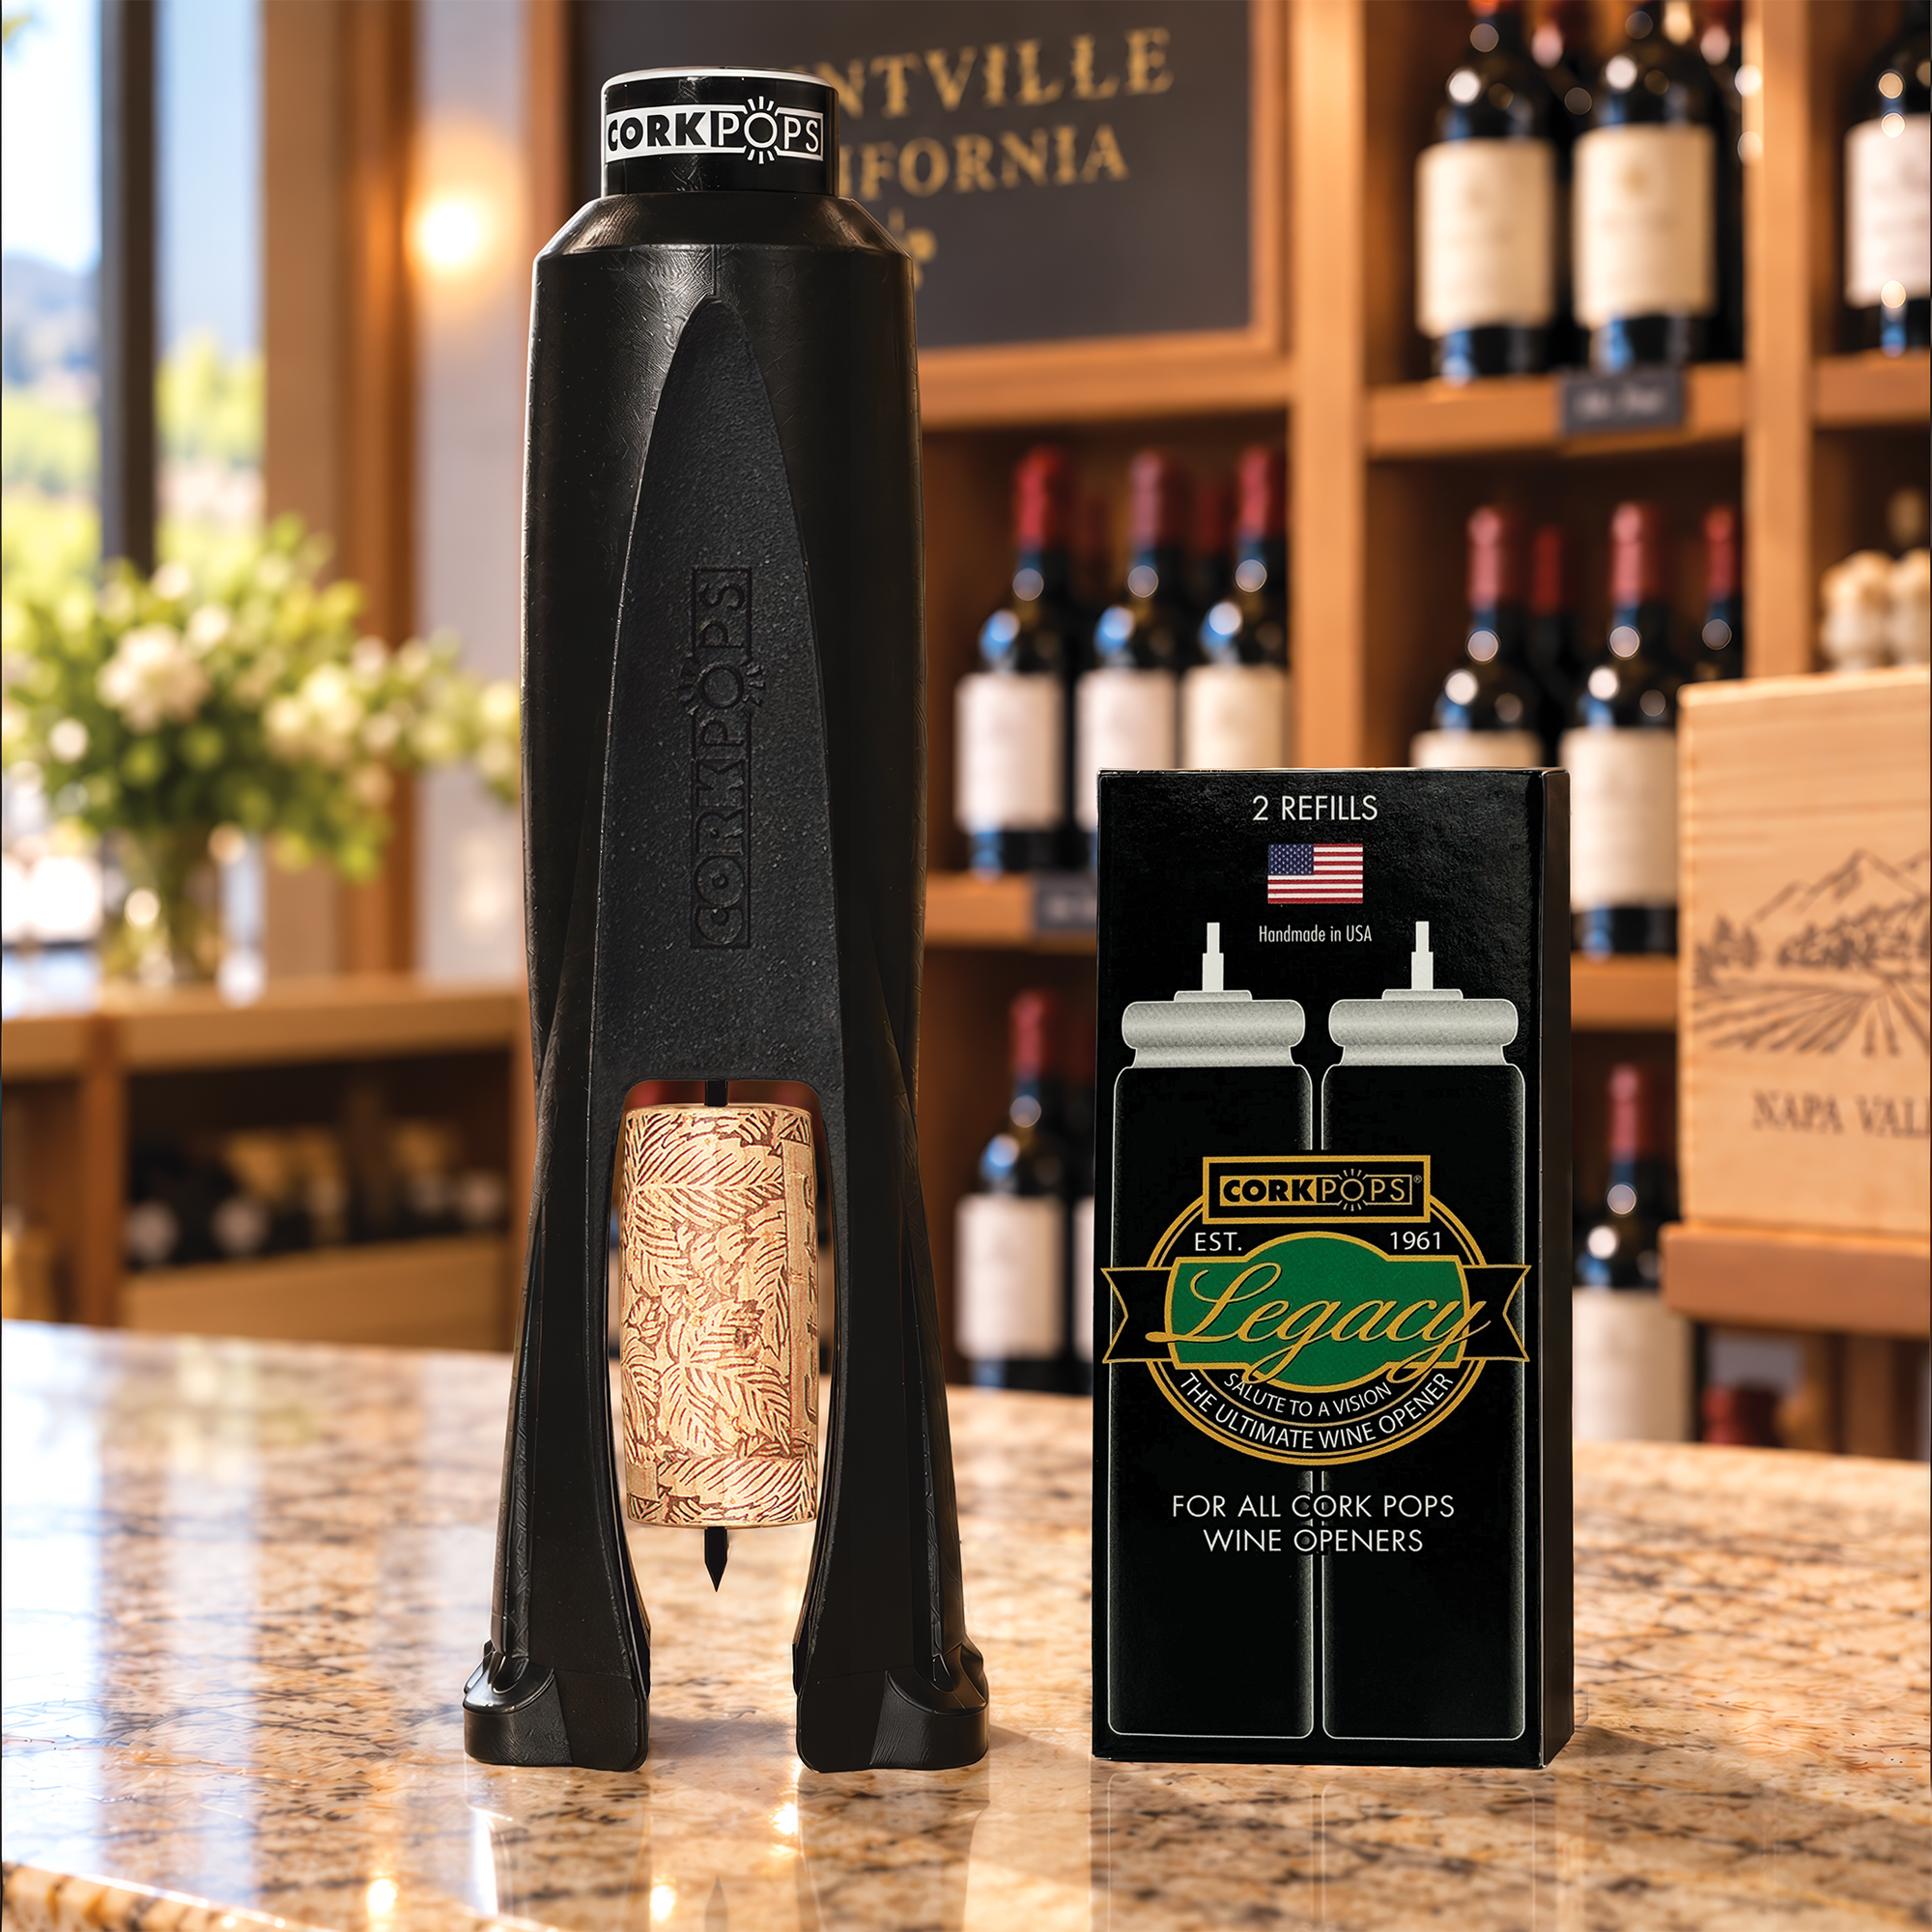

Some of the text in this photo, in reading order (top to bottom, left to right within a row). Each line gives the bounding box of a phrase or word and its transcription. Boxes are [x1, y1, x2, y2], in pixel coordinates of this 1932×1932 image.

[799, 27, 1175, 120] NTVILLE
[838, 123, 1130, 201] IFORNIA
[1252, 795, 1378, 821] 2 REFILLS
[1259, 923, 1373, 943] Handmade in USA
[1751, 1091, 1929, 1140] NAPA VAL
[1194, 1231, 1442, 1253] EST. 1961
[1145, 1262, 1492, 1384] Legacy
[1179, 1372, 1454, 1449] THE ULTIMATE WINE OPENER
[1223, 1373, 1393, 1417] SALUTE TO A VISION
[1172, 1494, 1455, 1518] FOR ALL CORK POPS
[1203, 1529, 1424, 1552] WINE OPENERS
